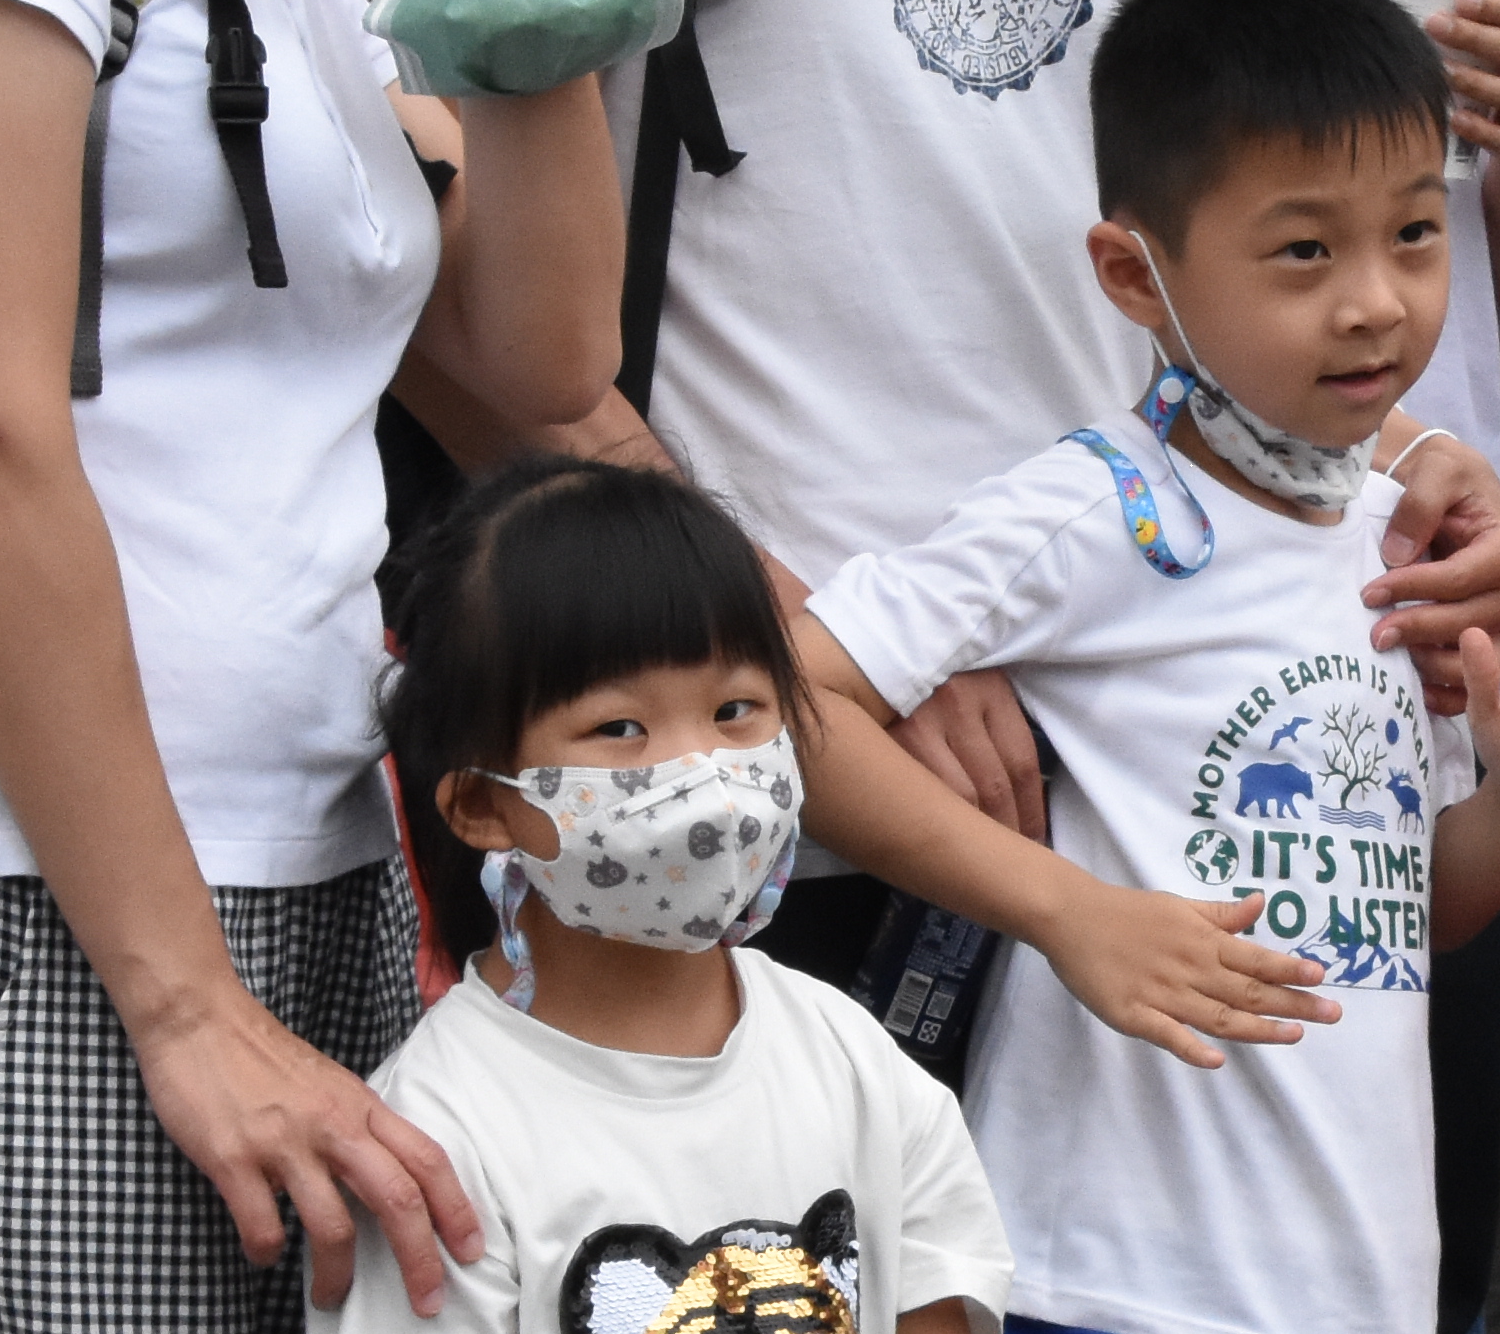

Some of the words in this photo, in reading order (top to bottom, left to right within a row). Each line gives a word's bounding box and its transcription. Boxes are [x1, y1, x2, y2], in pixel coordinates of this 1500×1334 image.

[1191, 685, 1276, 820] MOTHER
[1279, 654, 1361, 696] EARTH
[1370, 664, 1387, 695] IS
[1251, 829, 1337, 884] IT'S
[1350, 839, 1424, 893] TIME
